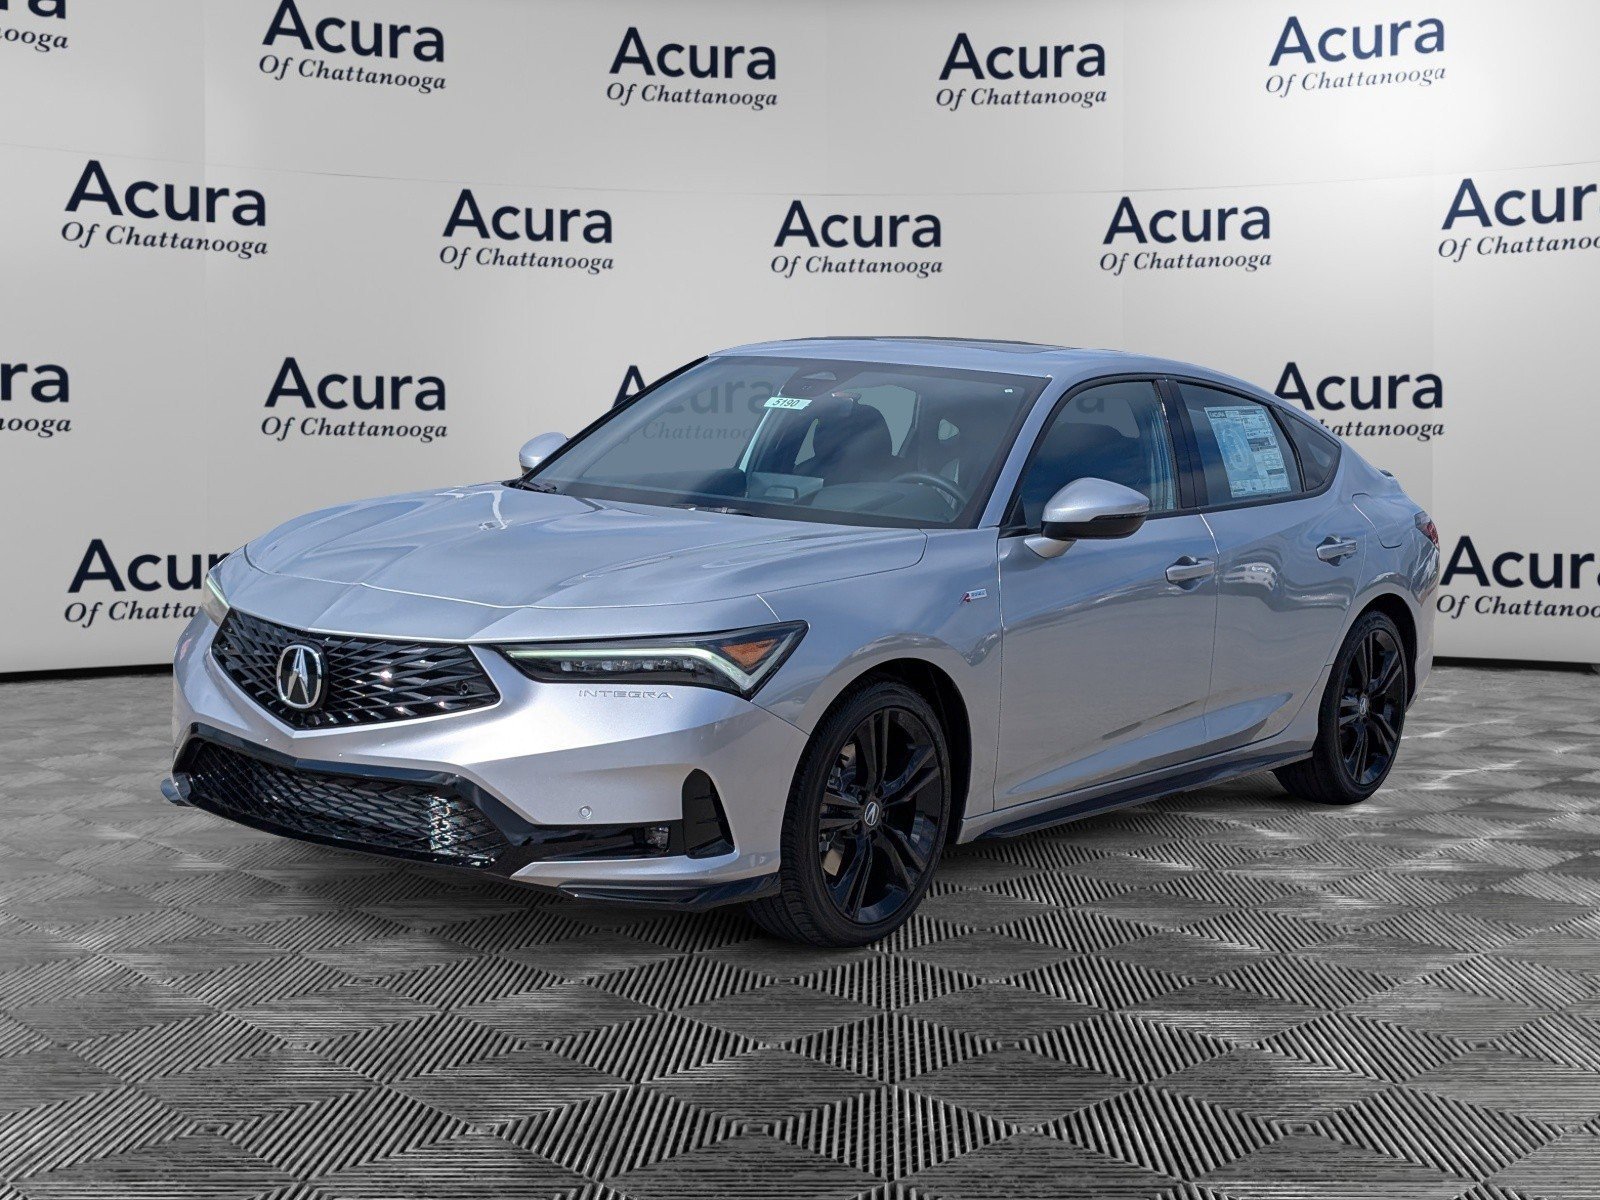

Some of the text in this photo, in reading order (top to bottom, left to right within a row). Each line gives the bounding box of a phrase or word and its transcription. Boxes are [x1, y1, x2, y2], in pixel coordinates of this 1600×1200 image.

[262, 0, 445, 62] Acura
[1268, 15, 1445, 67] Acura
[608, 27, 777, 80] Acura
[938, 32, 1106, 81] Acura
[259, 55, 446, 94] Of Chattanooga
[1265, 67, 1446, 98] Of Chattanooga
[606, 83, 778, 110] Of Chattanooga
[935, 87, 1107, 111] Of Chattanooga
[65, 159, 266, 227] Acura
[1441, 178, 1600, 230] Acur
[441, 189, 613, 244] Acura
[774, 200, 942, 249] Acura
[1102, 197, 1271, 244] Acura
[61, 222, 268, 259] Of Chattanooga
[1438, 235, 1600, 262] Of Chattanoo
[439, 246, 614, 275] Of Chattanooga
[771, 255, 943, 278] Of Chattanooga
[1099, 251, 1271, 276] Of Chattanooga
[264, 357, 446, 412] Acura
[773, 399, 799, 407] 5190
[1274, 361, 1443, 411] Acura
[261, 416, 448, 443] Of Chattanooga
[1320, 419, 1445, 442] attanooga
[1439, 535, 1600, 589] Acur
[64, 600, 201, 628] Of Chatta
[1436, 594, 1600, 620] Of Chattanoo
[579, 689, 674, 700] INTEGRA
